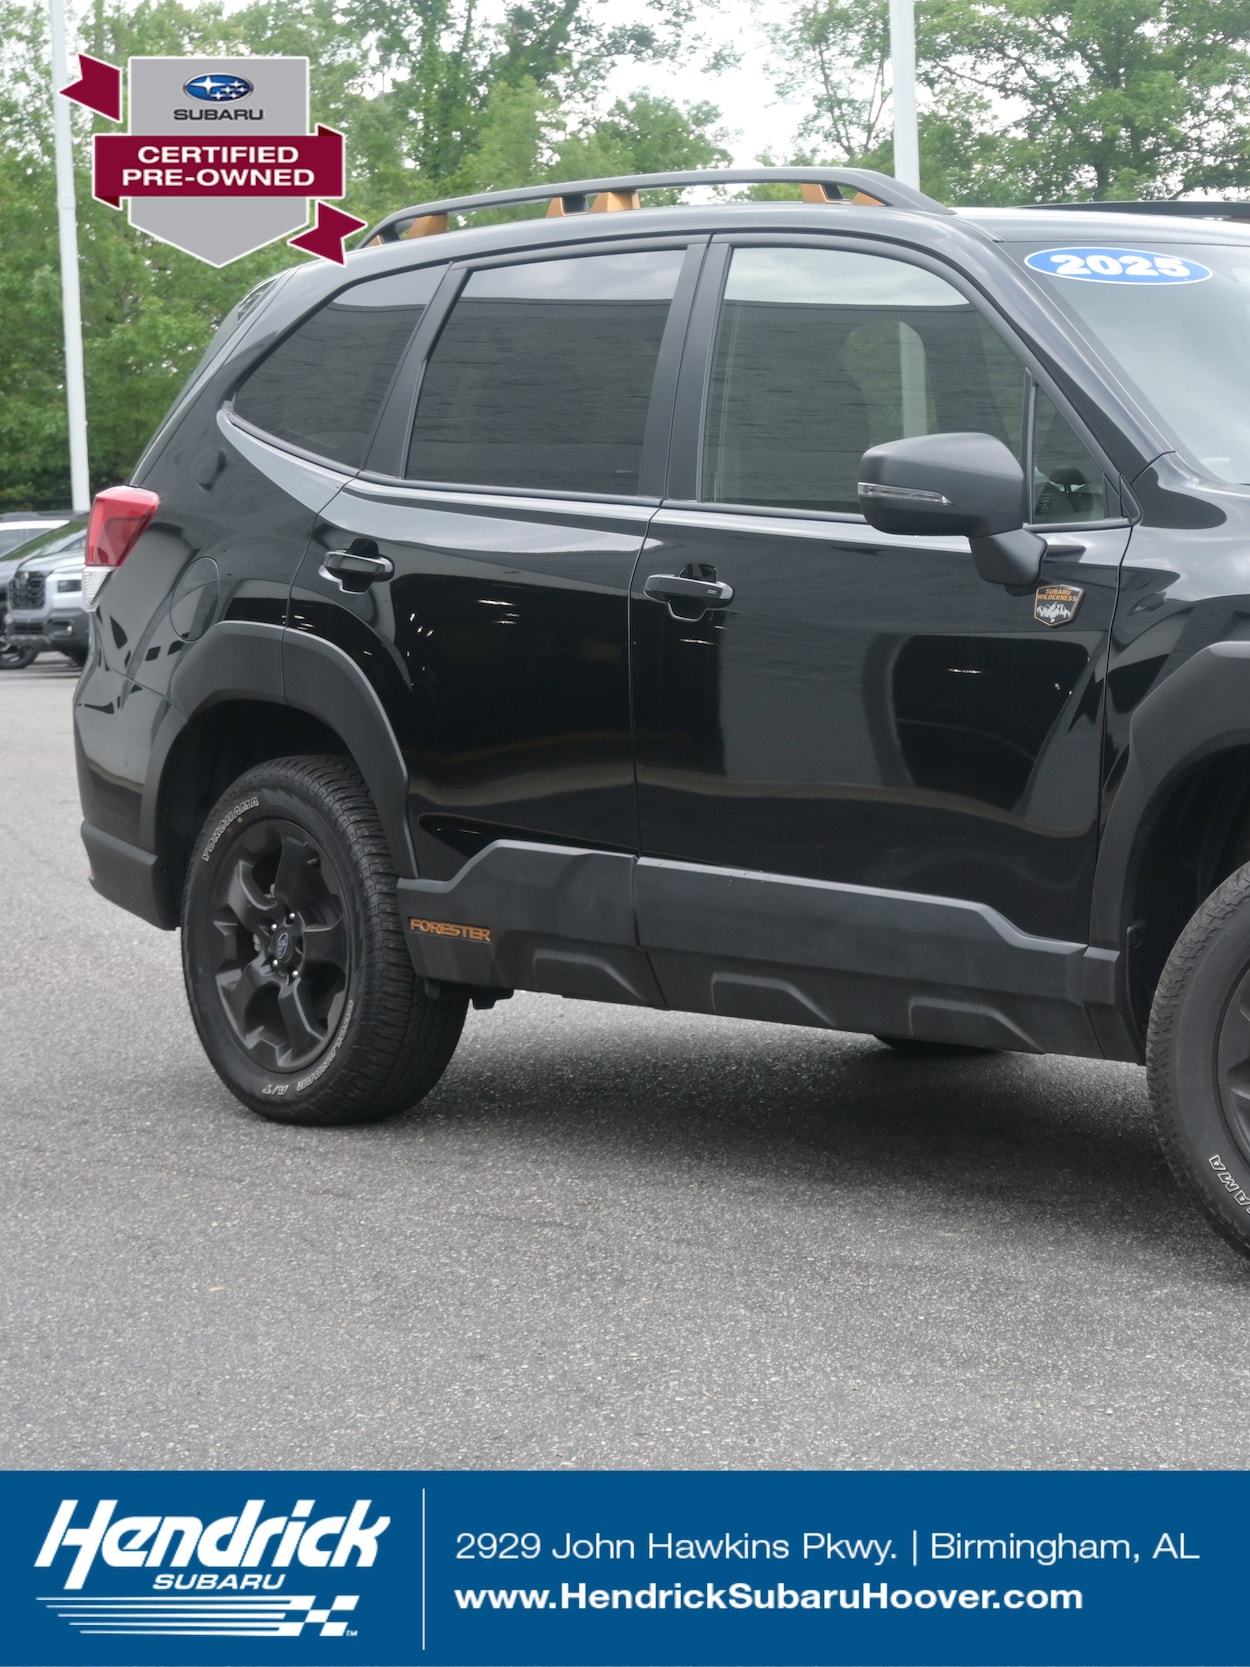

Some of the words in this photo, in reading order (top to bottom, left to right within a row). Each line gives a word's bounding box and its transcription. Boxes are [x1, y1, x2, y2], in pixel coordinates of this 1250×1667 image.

[1049, 254, 1192, 278] 2025
[201, 796, 260, 862] YOKOHAMA
[410, 918, 492, 942] FORESTER
